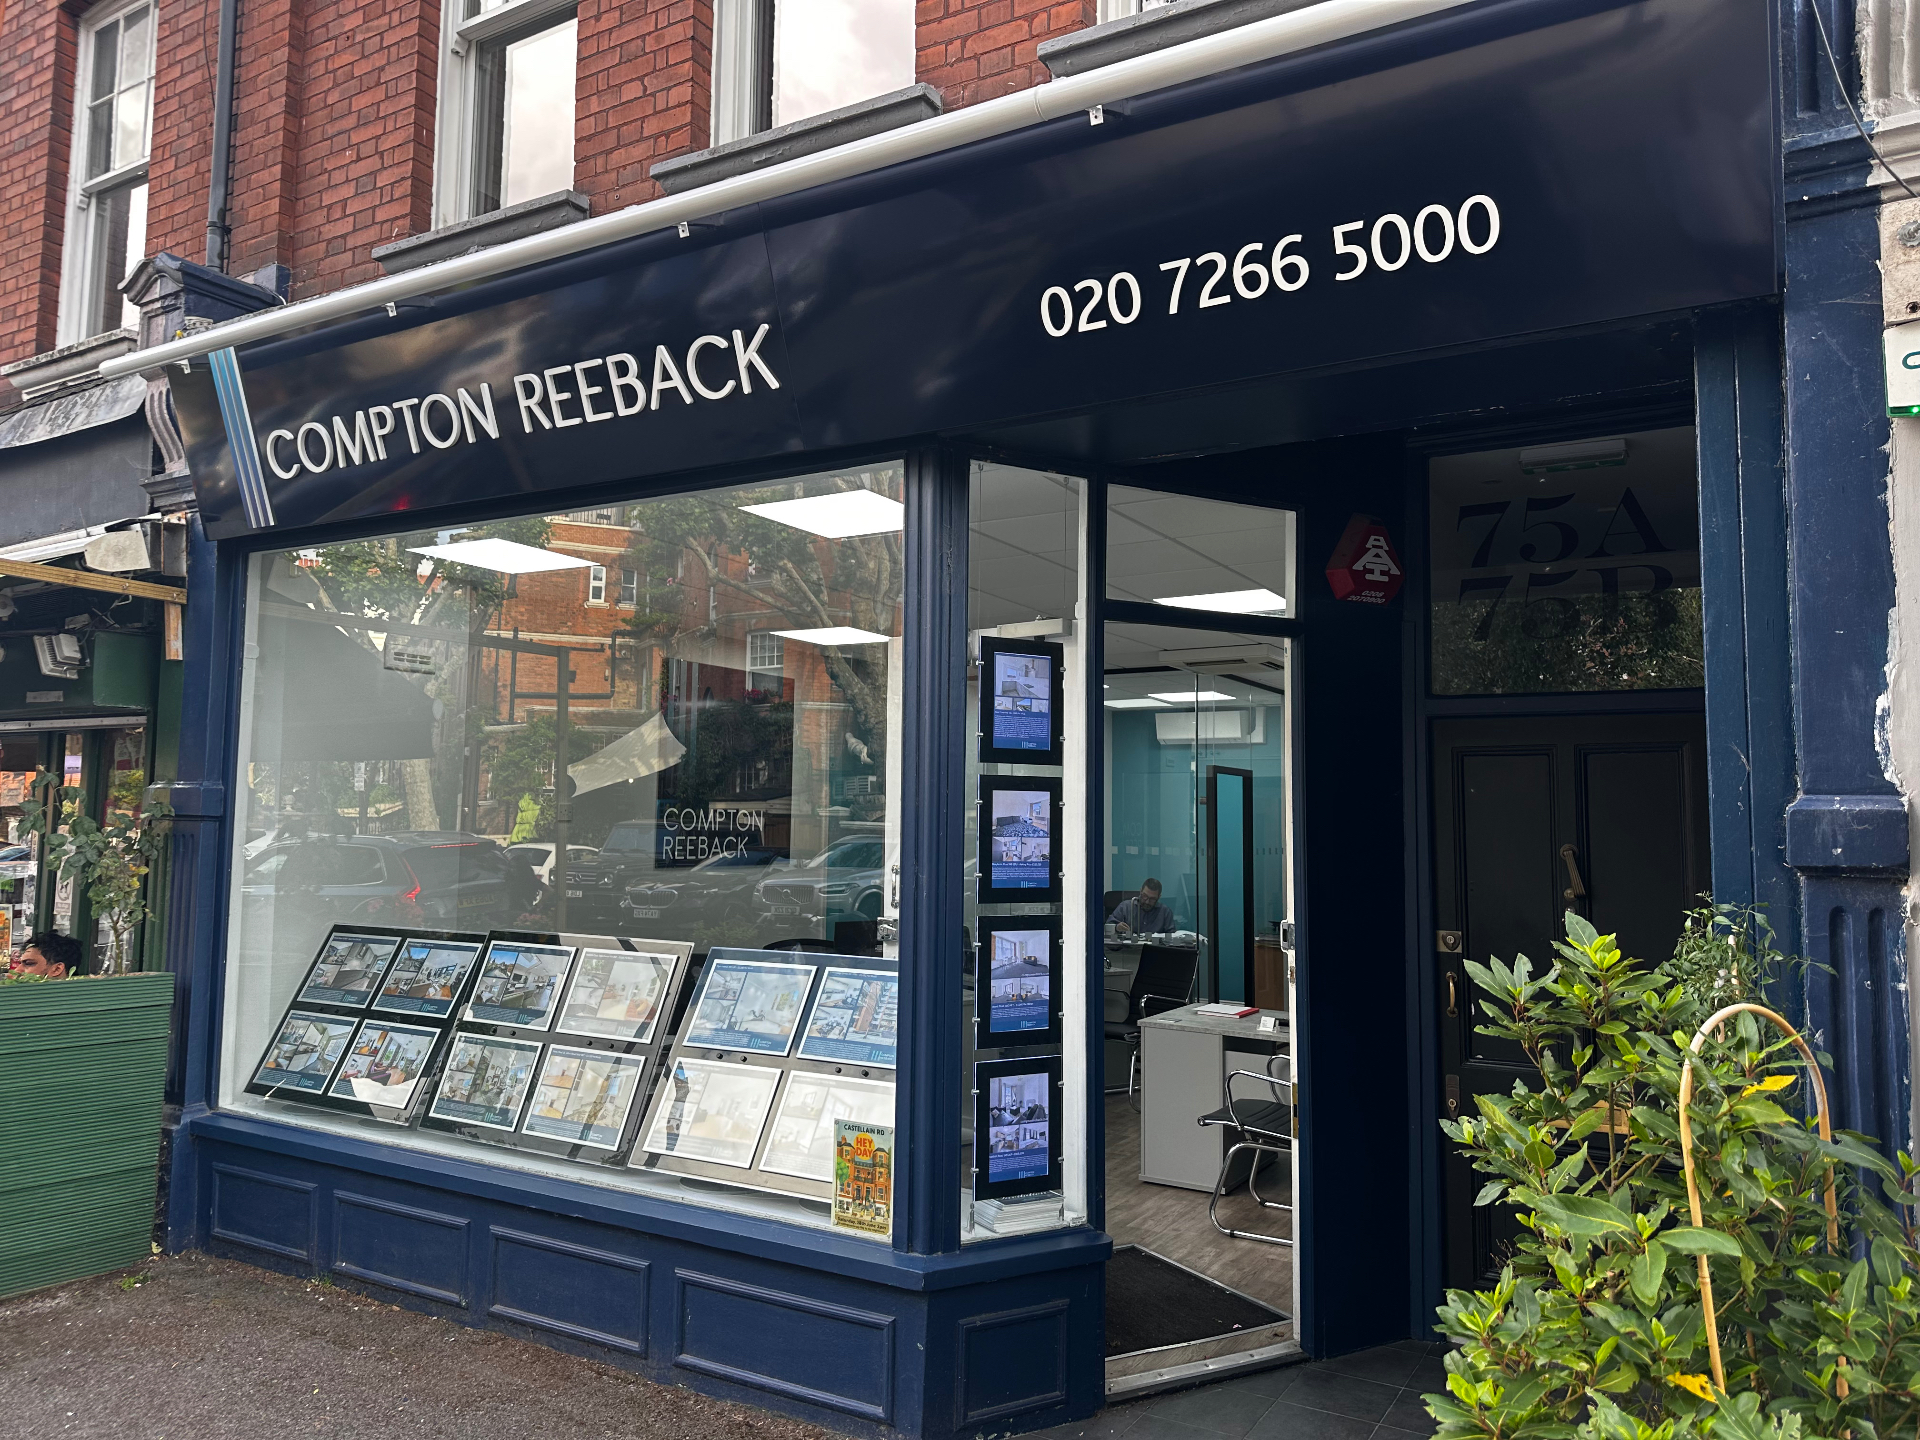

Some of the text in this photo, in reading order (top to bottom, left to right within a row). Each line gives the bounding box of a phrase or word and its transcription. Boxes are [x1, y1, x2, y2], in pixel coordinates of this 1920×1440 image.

[1040, 194, 1500, 337] 020 7266 5000
[265, 323, 781, 480] COMPTON REEBACK
[1456, 486, 1676, 568] 75A
[663, 807, 764, 831] COMPTON
[662, 836, 749, 860] REEBACK
[844, 1124, 885, 1136] CASTELLAIN RD
[856, 1136, 873, 1148] HEY
[855, 1147, 873, 1158] DAY
